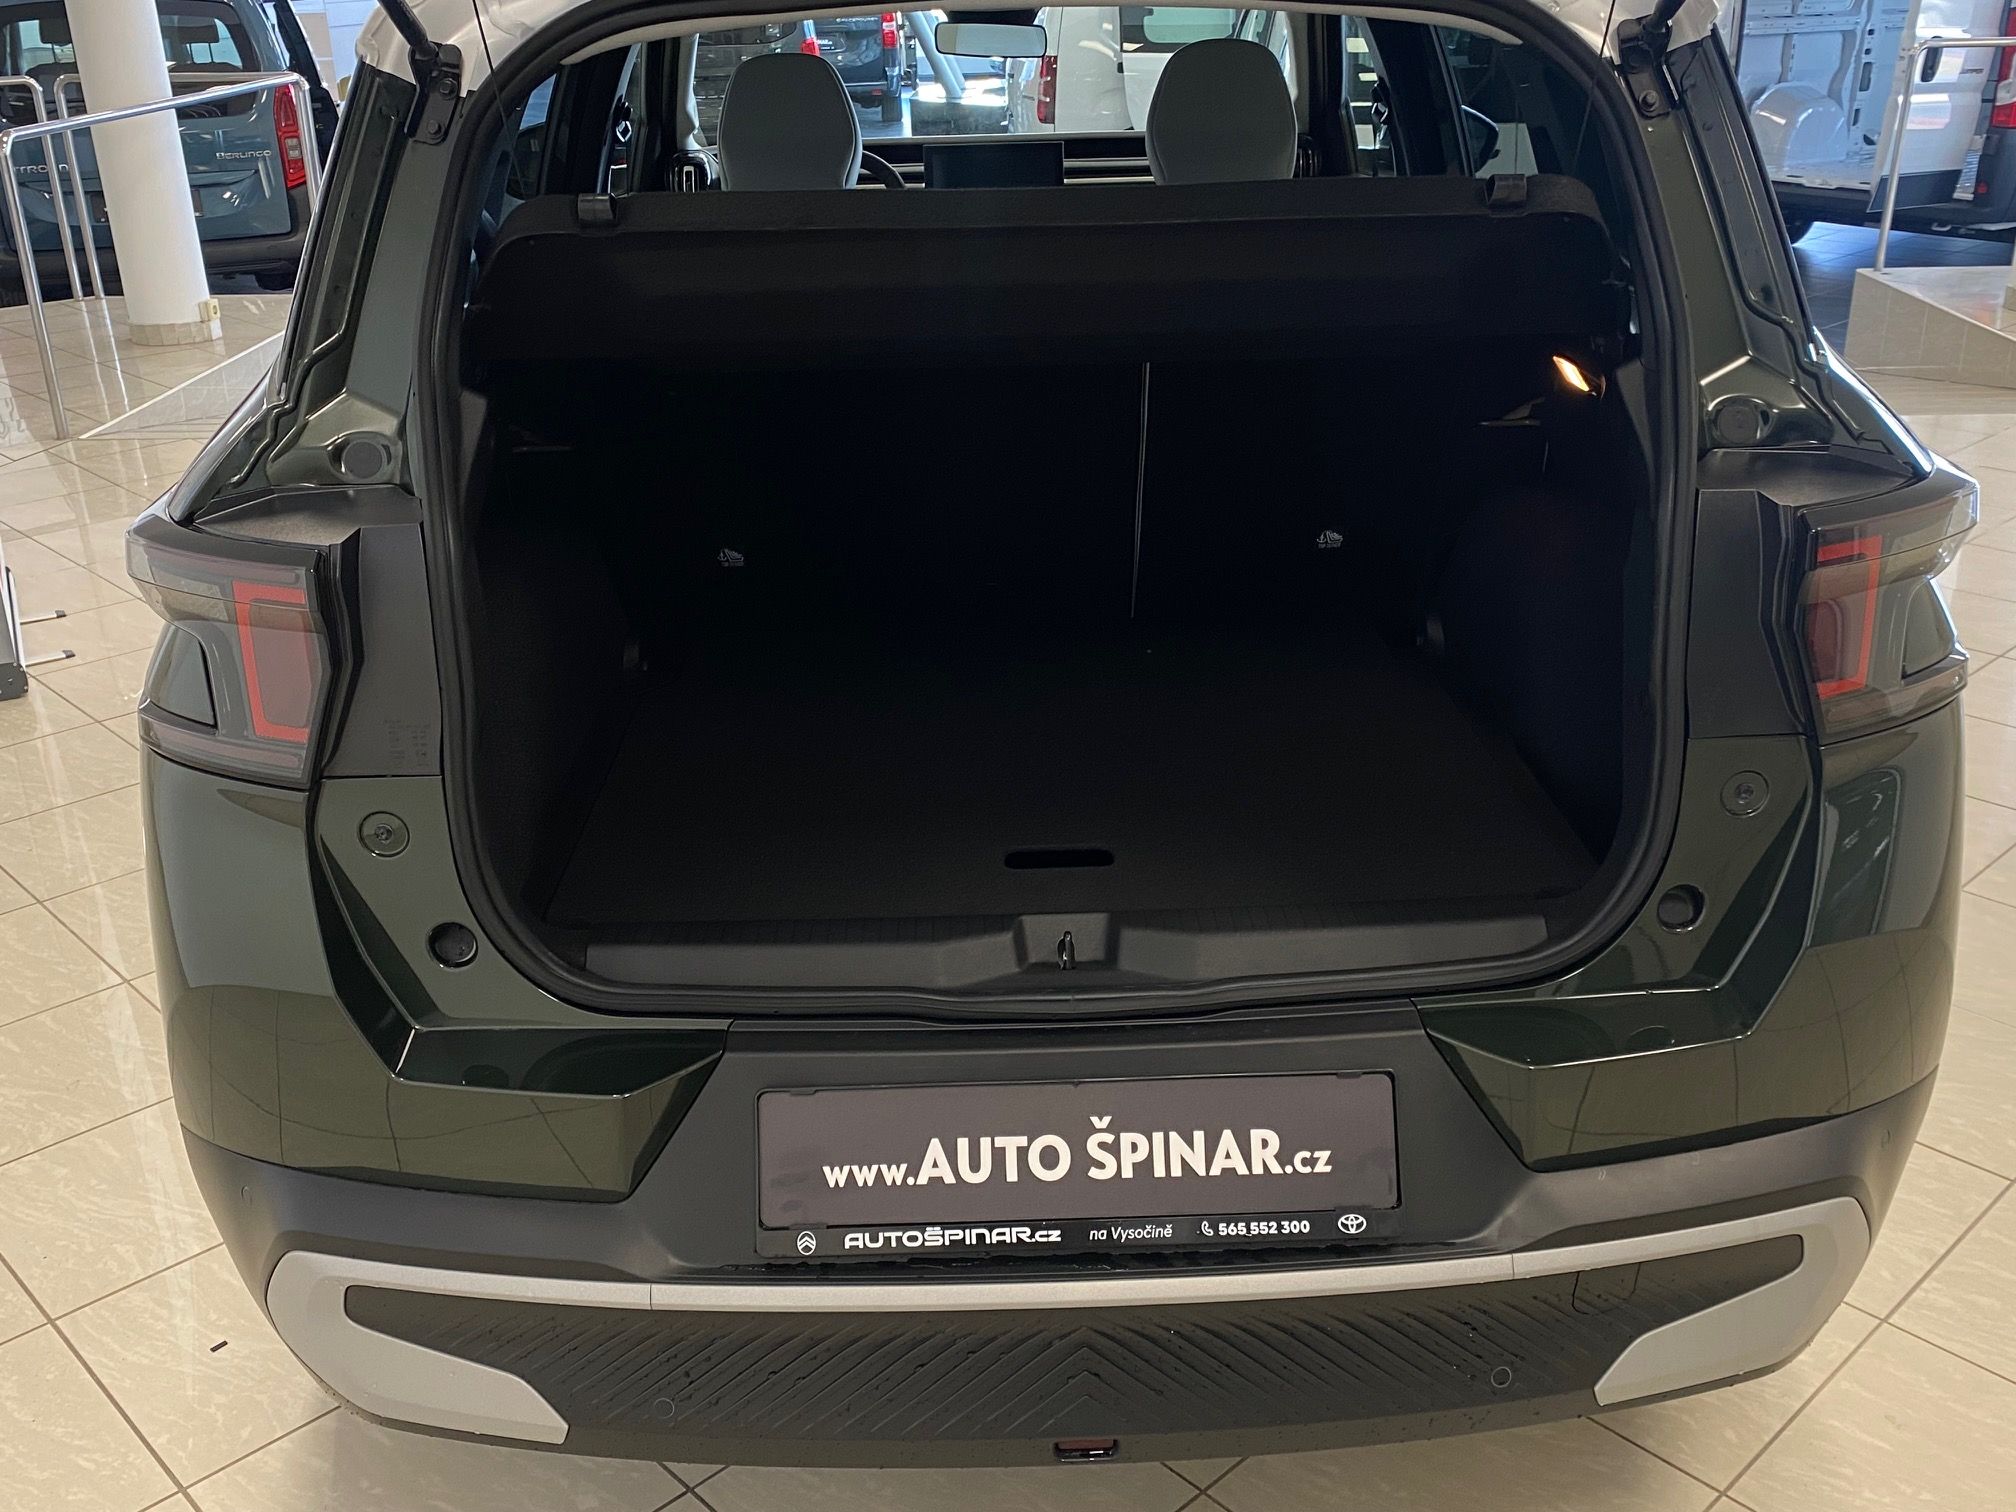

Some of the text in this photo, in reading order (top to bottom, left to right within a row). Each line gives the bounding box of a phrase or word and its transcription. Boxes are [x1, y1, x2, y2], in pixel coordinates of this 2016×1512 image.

[822, 1115, 1333, 1188] www.AUTO ŠPINAR.cz
[844, 1220, 1311, 1250] AUTOŠPINAR.cz na Vysočině 565 552 300
